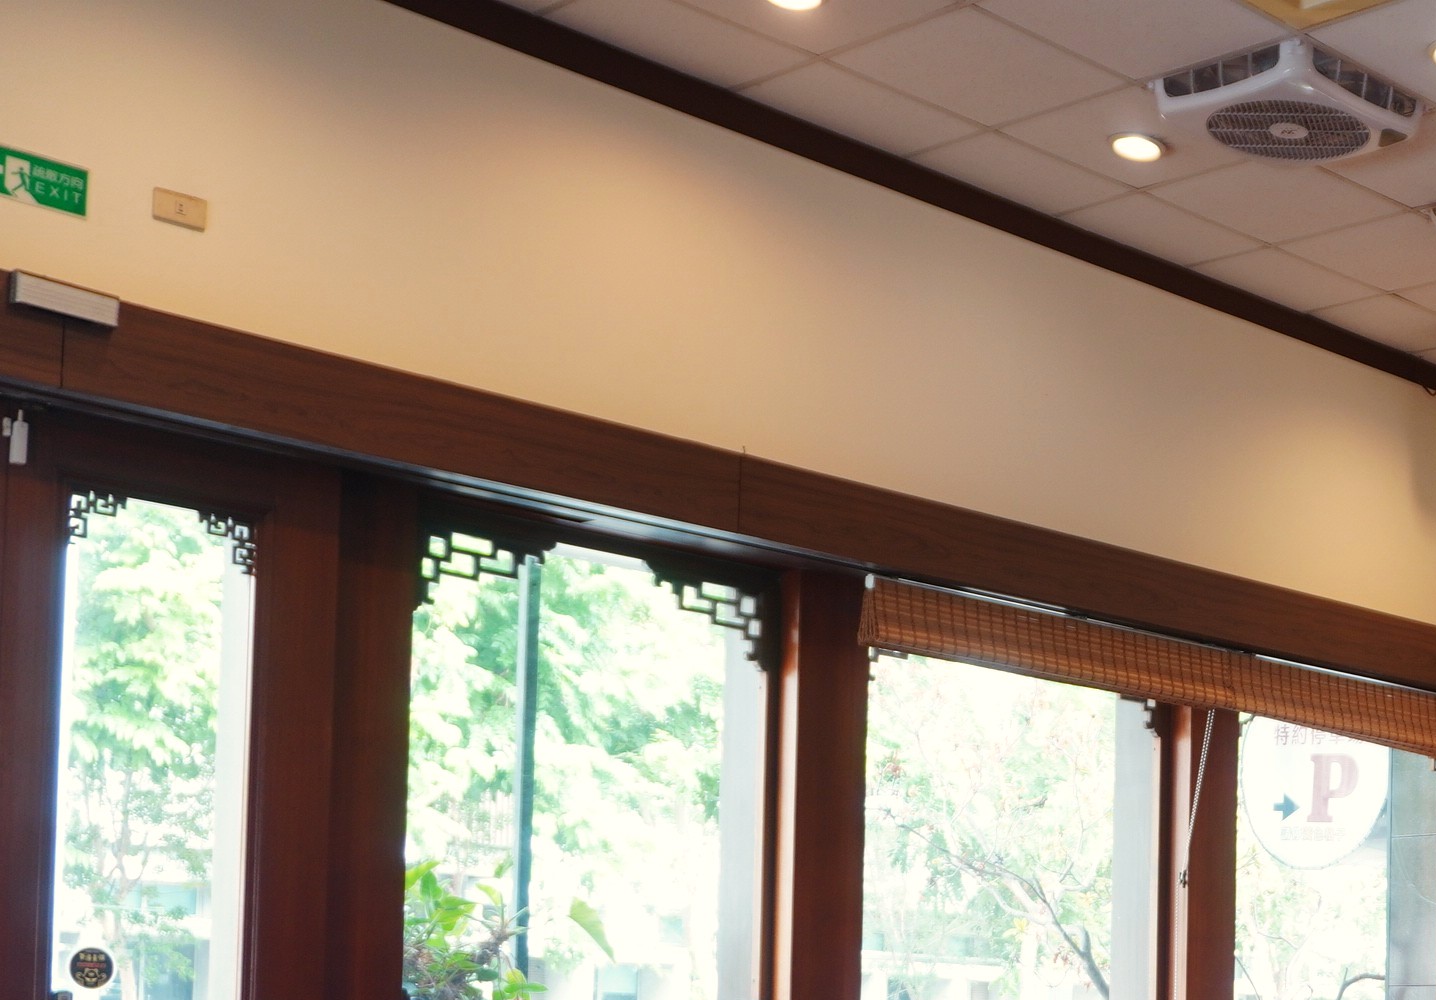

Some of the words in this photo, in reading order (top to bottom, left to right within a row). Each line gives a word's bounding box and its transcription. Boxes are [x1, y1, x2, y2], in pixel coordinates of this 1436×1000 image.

[35, 181, 82, 204] EXIT
[1274, 723, 1362, 746] 特約停
[1306, 753, 1360, 822] P
